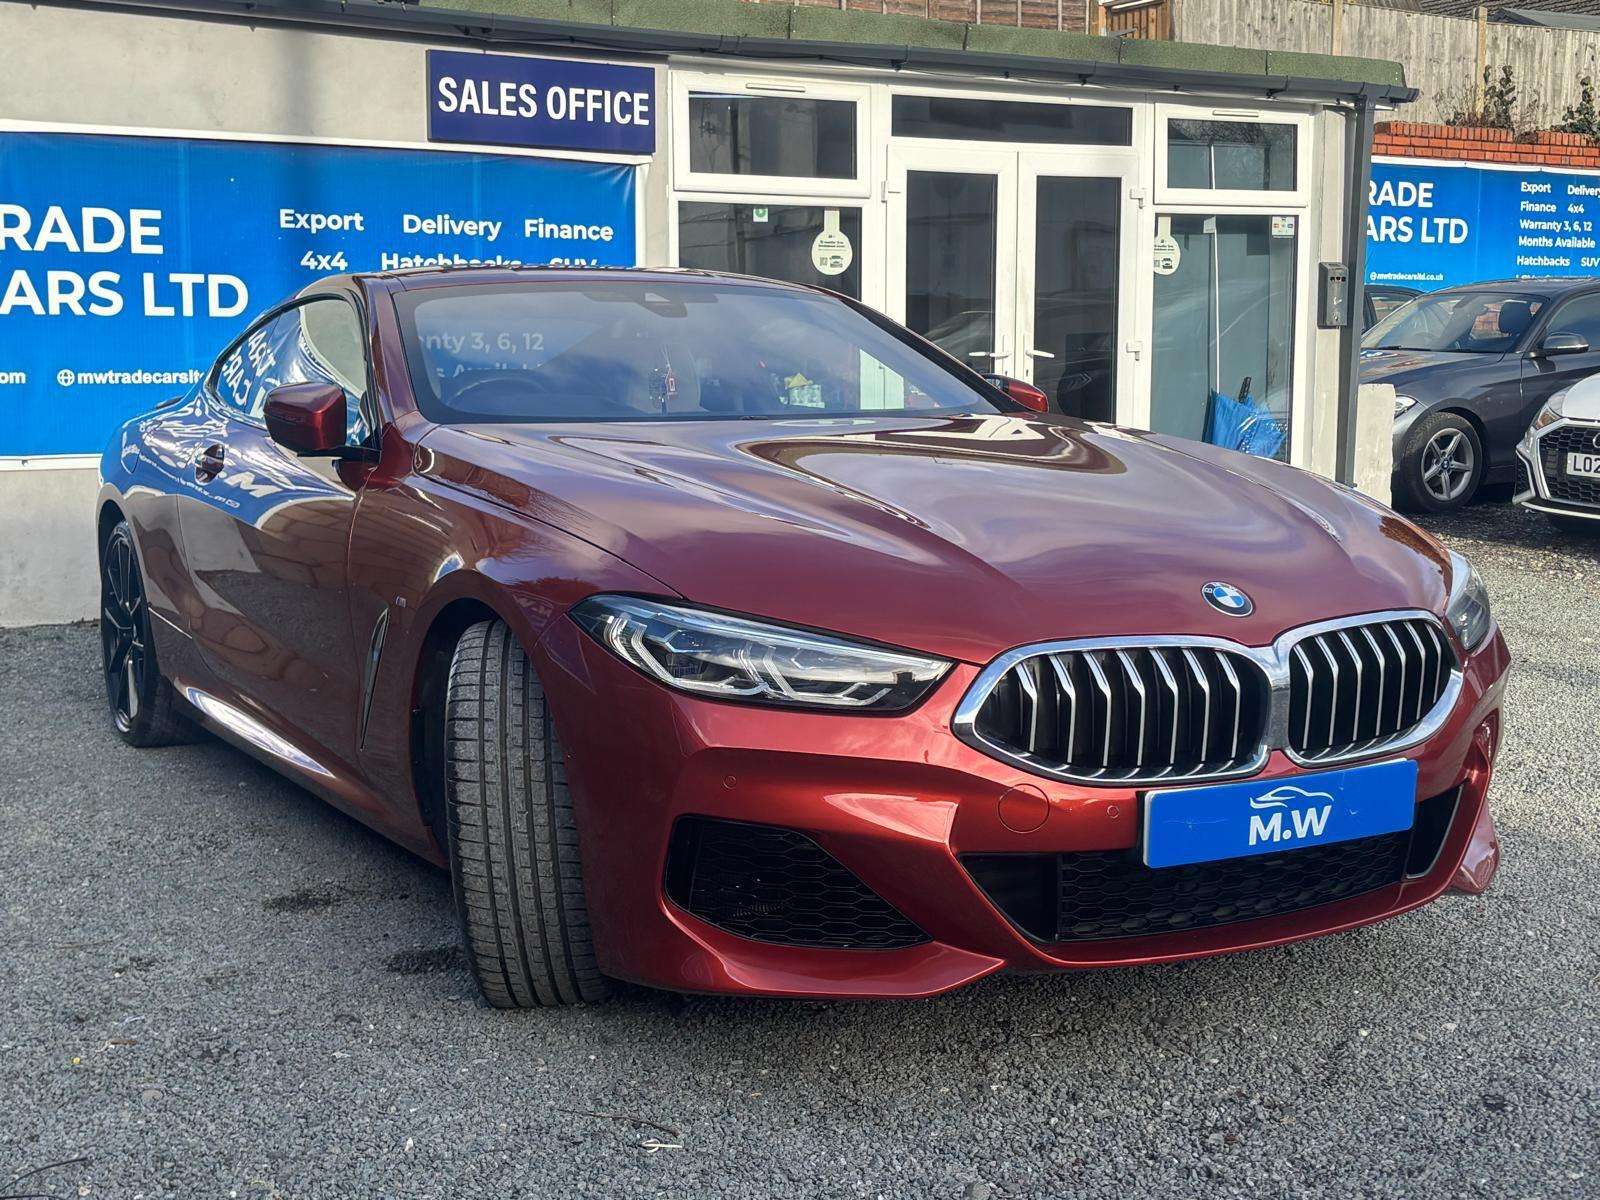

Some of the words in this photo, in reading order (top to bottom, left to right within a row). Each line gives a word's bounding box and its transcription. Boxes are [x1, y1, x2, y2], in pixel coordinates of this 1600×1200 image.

[438, 76, 538, 118] SALES
[546, 86, 650, 126] OFFICE
[1520, 181, 1552, 195] Export
[1520, 200, 1557, 213] Finance
[1567, 203, 1585, 214] 4x4
[279, 208, 365, 234] Export
[402, 214, 502, 242] Delivery
[524, 218, 614, 242] Finance
[1420, 217, 1469, 244] LTD
[1519, 219, 1562, 232] Warranty
[1583, 221, 1592, 231] 12
[1518, 236, 1553, 248] Months
[1555, 236, 1596, 248] Available
[300, 250, 348, 271] 4x4
[1516, 255, 1570, 267] Hatchbacks
[143, 272, 249, 318] LTD
[471, 332, 490, 353] 3,
[497, 332, 516, 354] 6,
[522, 332, 545, 350] 12
[1248, 805, 1332, 846] M.W
